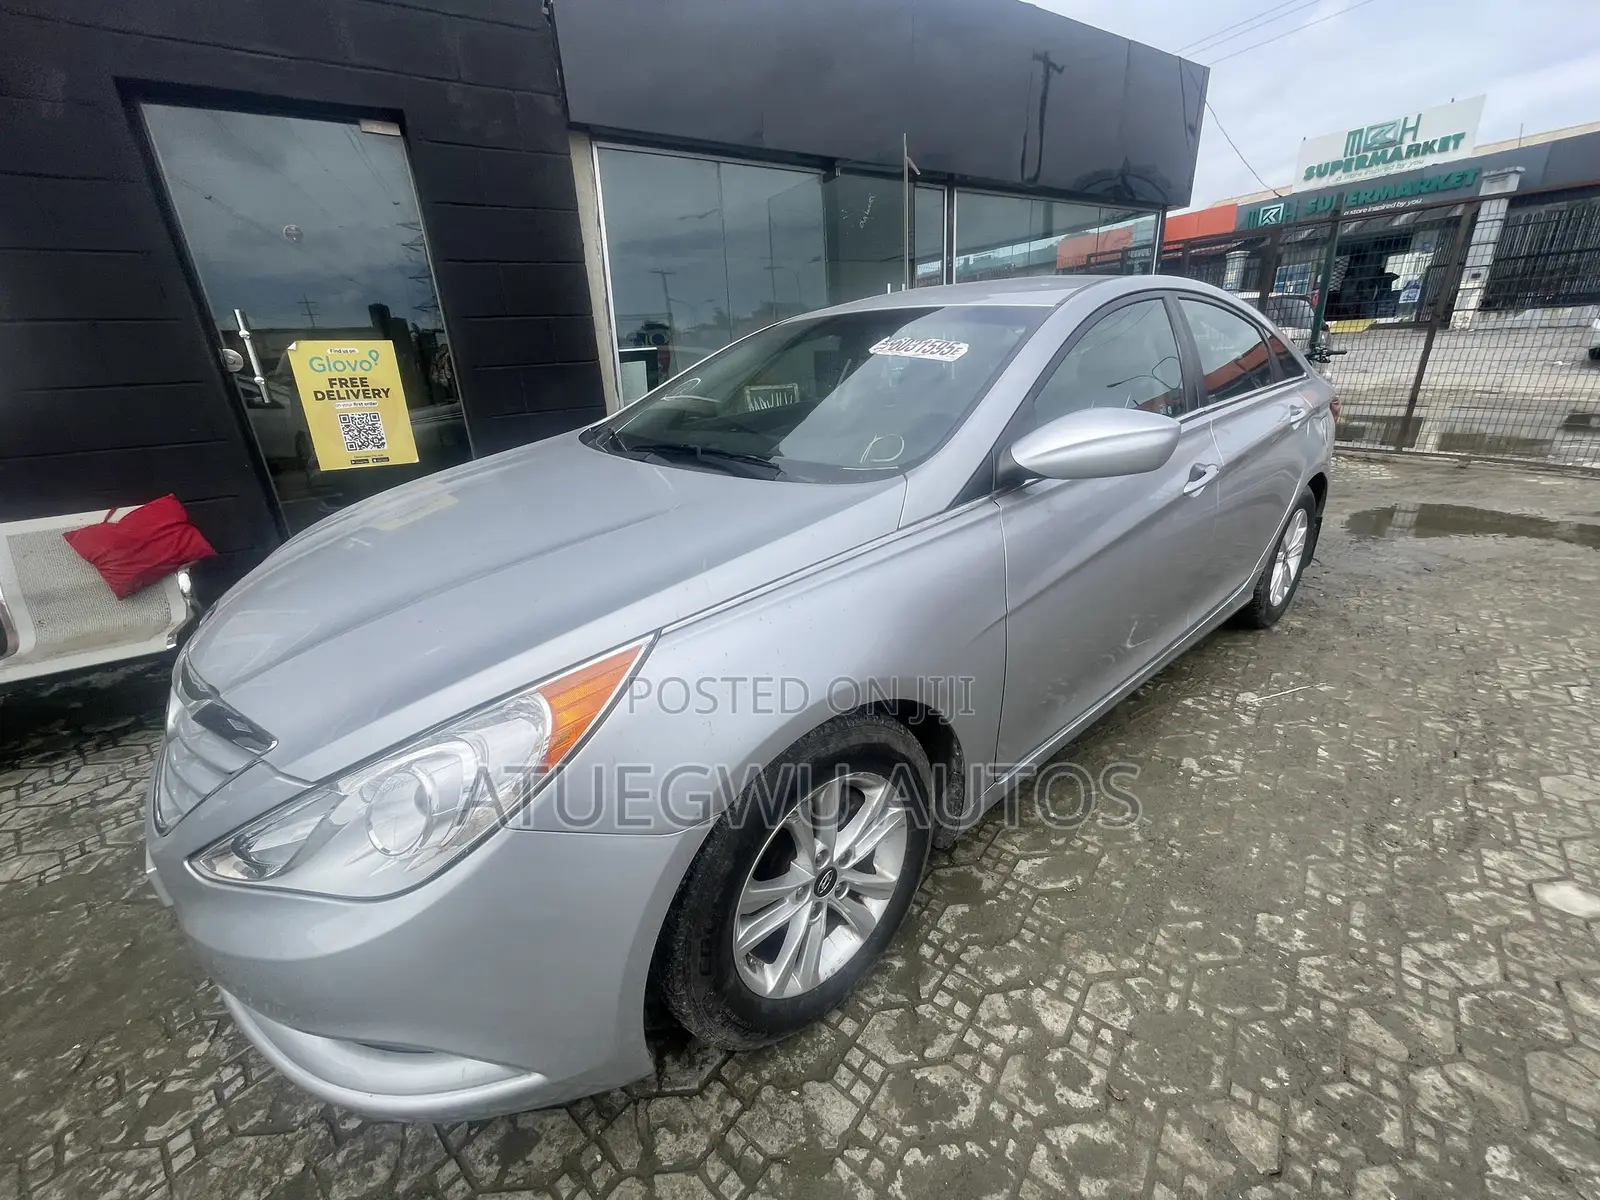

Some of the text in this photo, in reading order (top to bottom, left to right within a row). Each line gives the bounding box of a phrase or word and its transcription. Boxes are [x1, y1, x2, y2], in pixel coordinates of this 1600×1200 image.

[1303, 132, 1466, 181] SUPERMARKET
[1408, 159, 1425, 170] you
[1304, 167, 1480, 216] SUERMARKET
[1350, 206, 1368, 215] store
[1368, 202, 1396, 212] inspired
[1396, 200, 1406, 208] by
[1405, 198, 1423, 208] you
[309, 354, 373, 373] Glovo
[327, 376, 370, 389] FREE
[313, 387, 391, 401] DELIVERY
